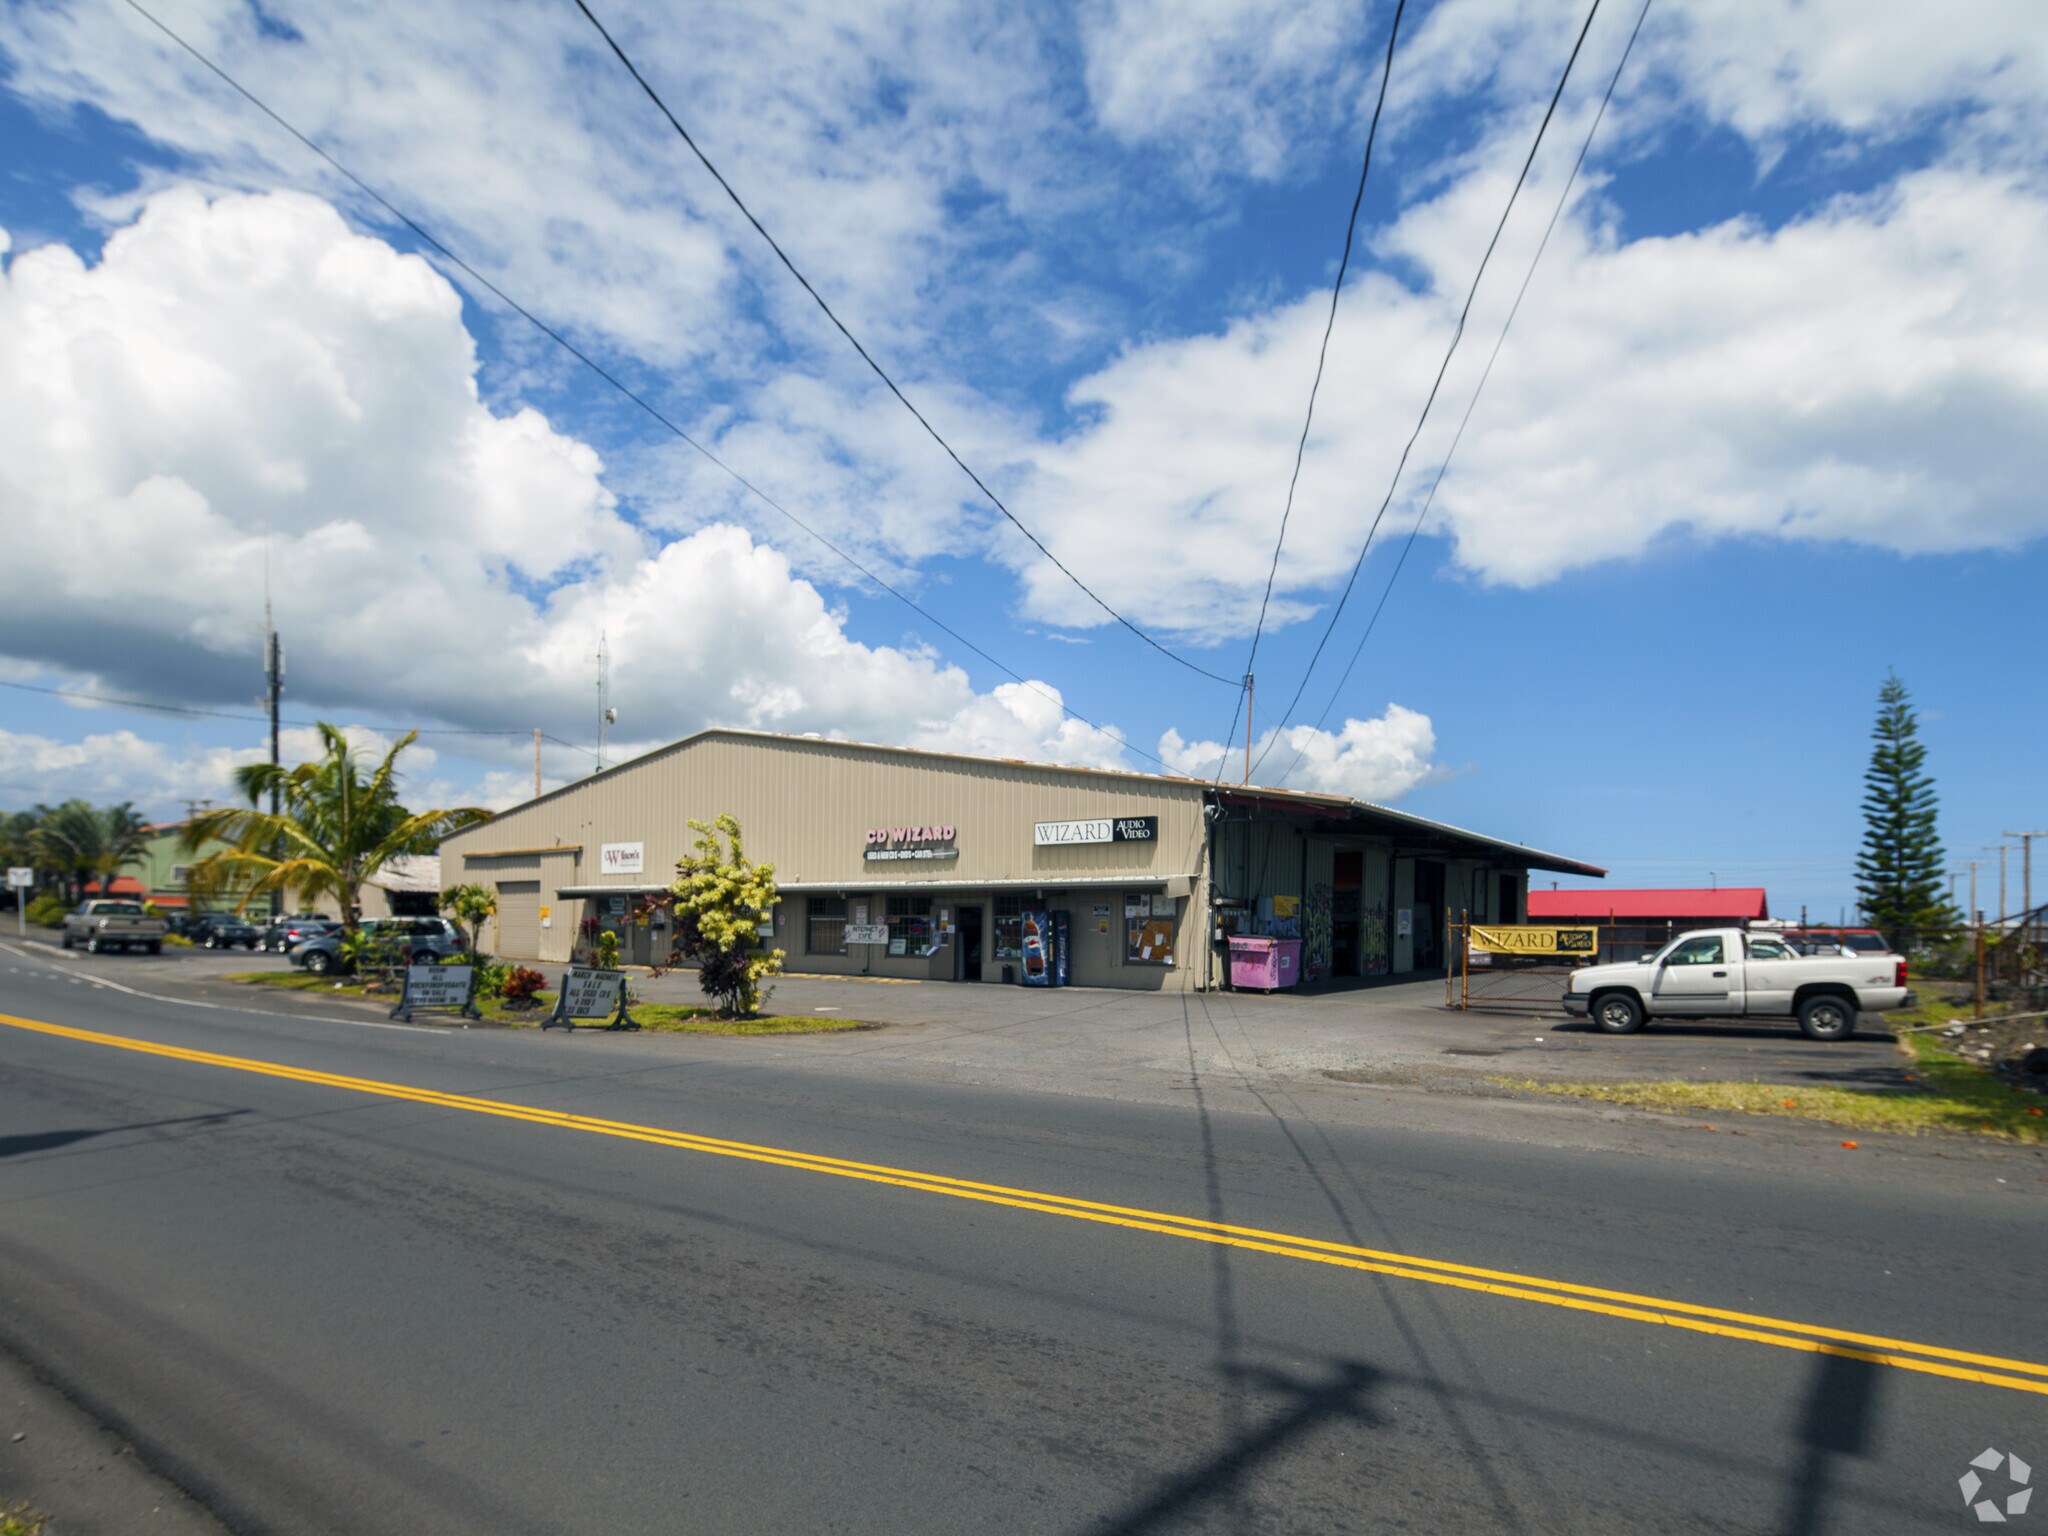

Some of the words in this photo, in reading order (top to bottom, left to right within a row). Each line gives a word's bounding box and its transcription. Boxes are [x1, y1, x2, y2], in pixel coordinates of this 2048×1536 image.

[866, 828, 888, 844] CD
[892, 825, 956, 842] WIZARD
[1037, 822, 1111, 842] WIZARD
[1116, 819, 1145, 831] AUDIO
[1123, 829, 1150, 839] VIDEO
[1478, 931, 1555, 948] WIZARD
[582, 981, 602, 989] SALE
